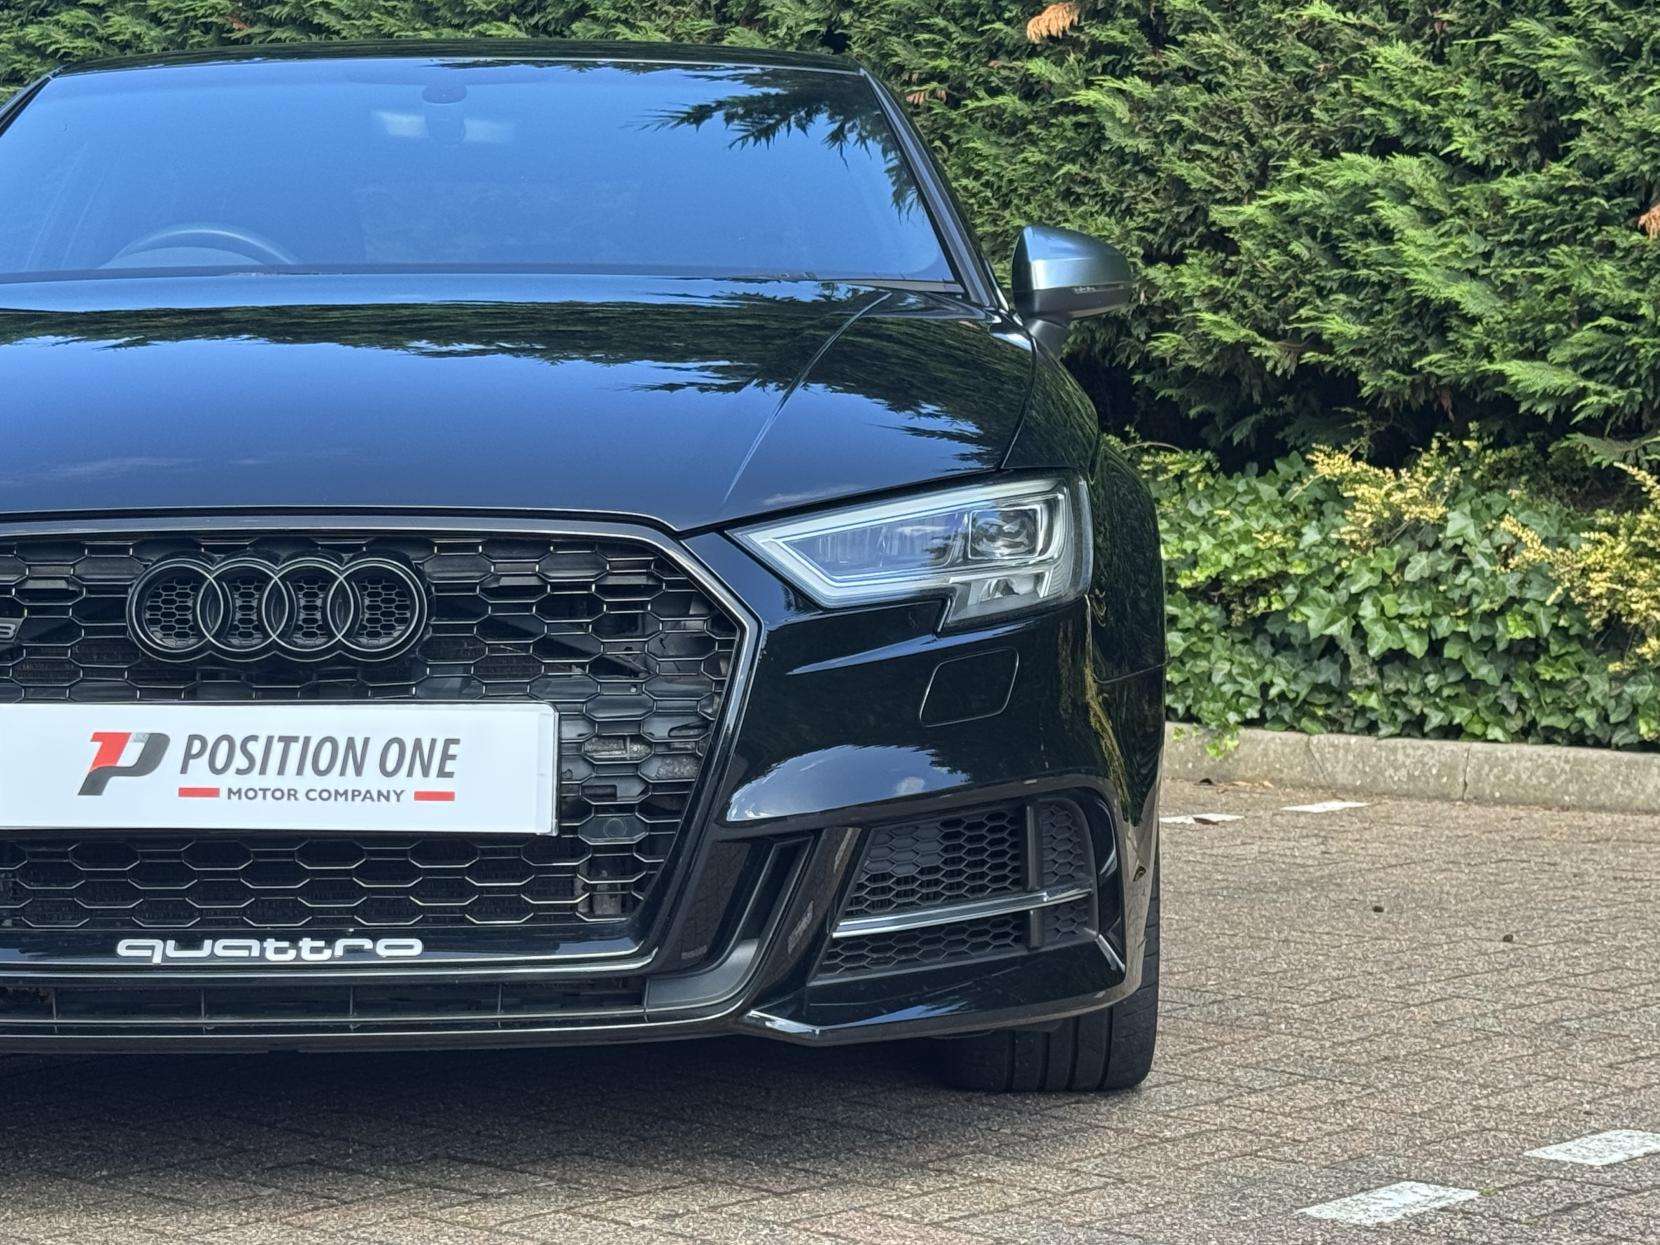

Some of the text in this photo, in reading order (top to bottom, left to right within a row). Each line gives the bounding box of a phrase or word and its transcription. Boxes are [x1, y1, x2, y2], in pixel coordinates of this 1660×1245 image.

[180, 733, 461, 779] POSITION ONE
[227, 786, 406, 803] MOTOR COMPANY
[116, 937, 424, 964] quattro
